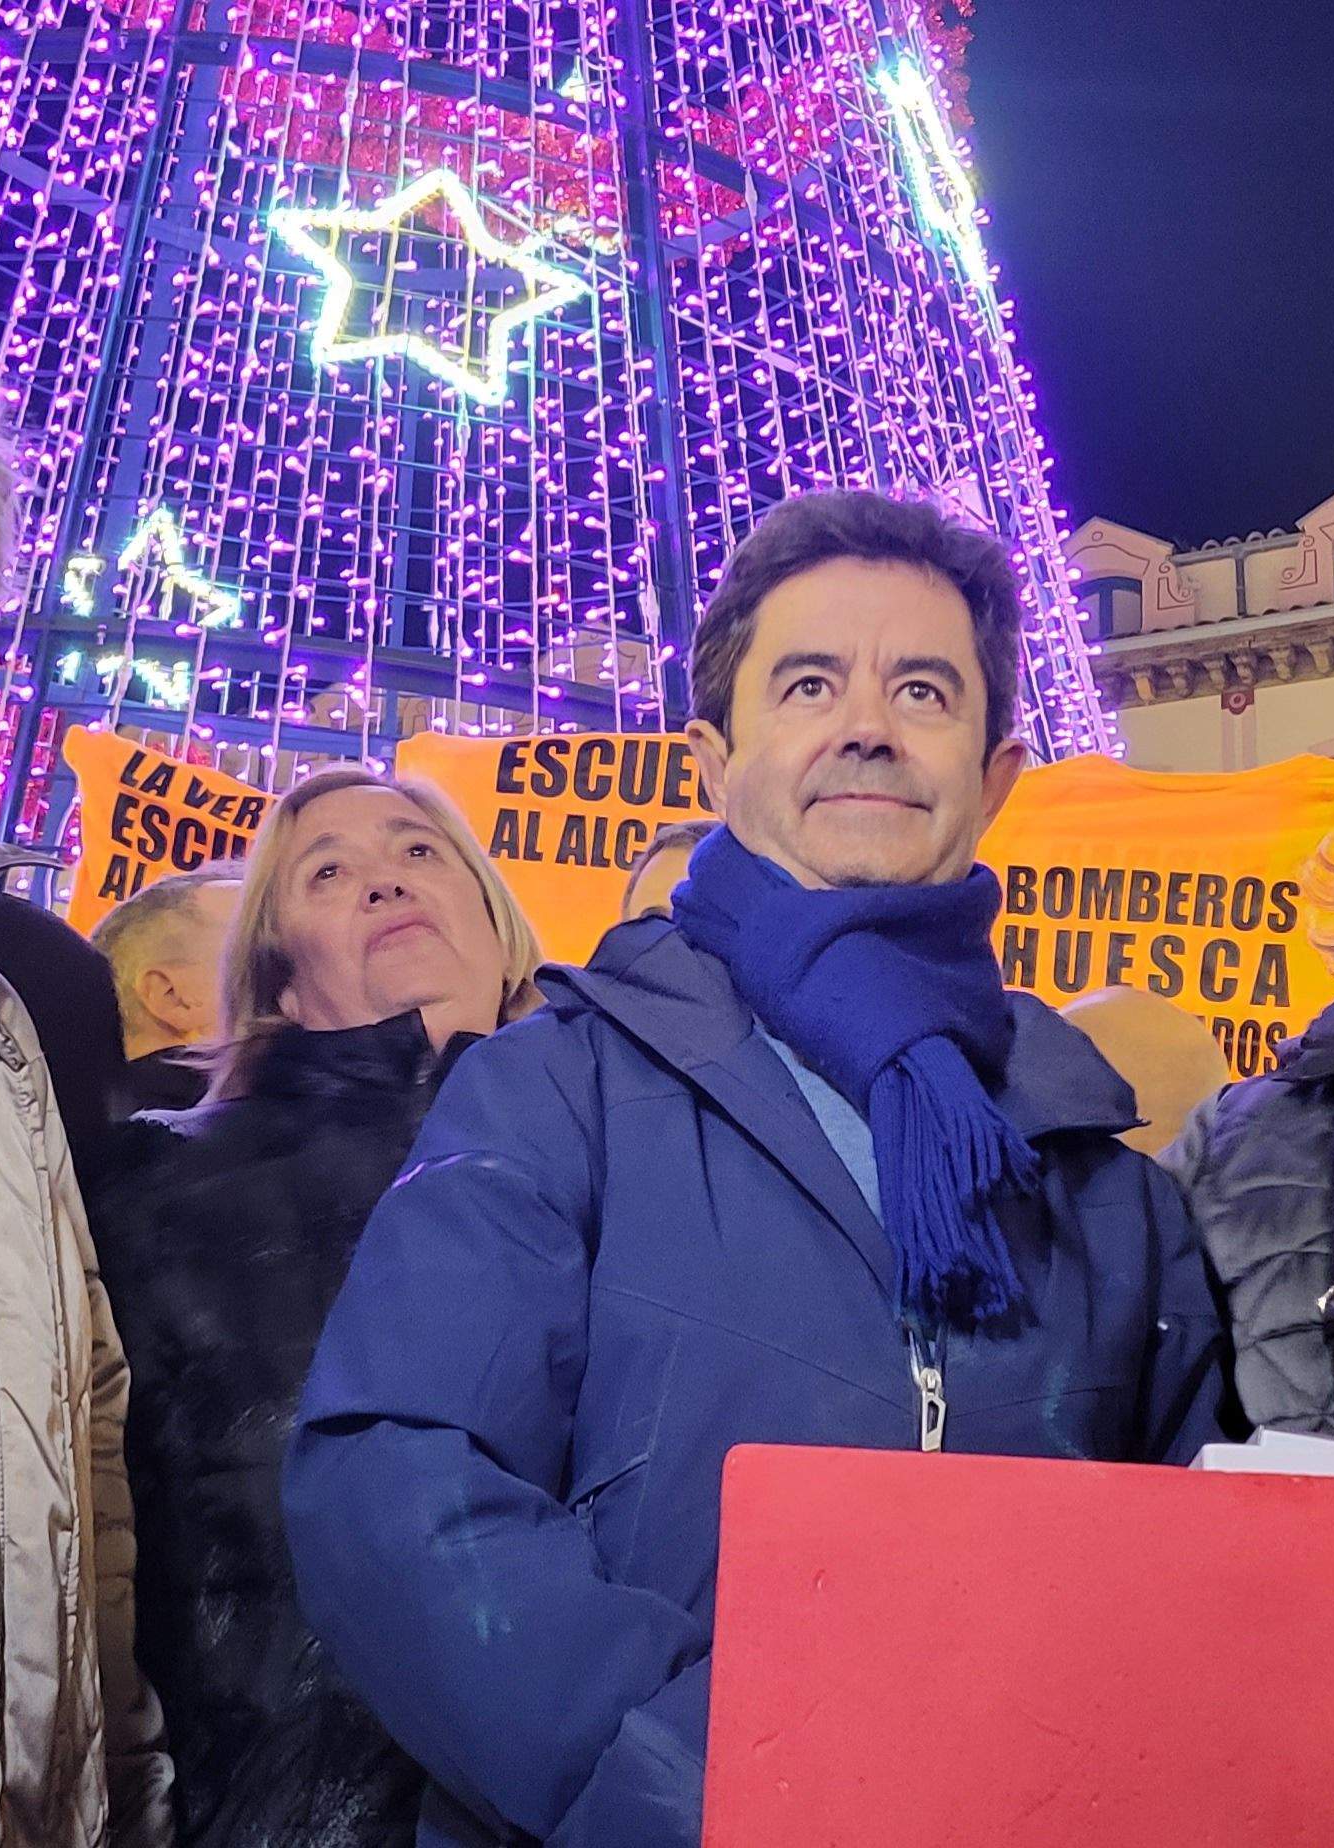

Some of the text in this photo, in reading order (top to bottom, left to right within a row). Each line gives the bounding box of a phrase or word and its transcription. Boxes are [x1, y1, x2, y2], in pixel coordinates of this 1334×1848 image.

[120, 750, 178, 798] LA
[489, 808, 675, 872] AL ALC
[1006, 865, 1301, 934] BOMBEROS
[1002, 924, 1291, 1008] HUESCA
